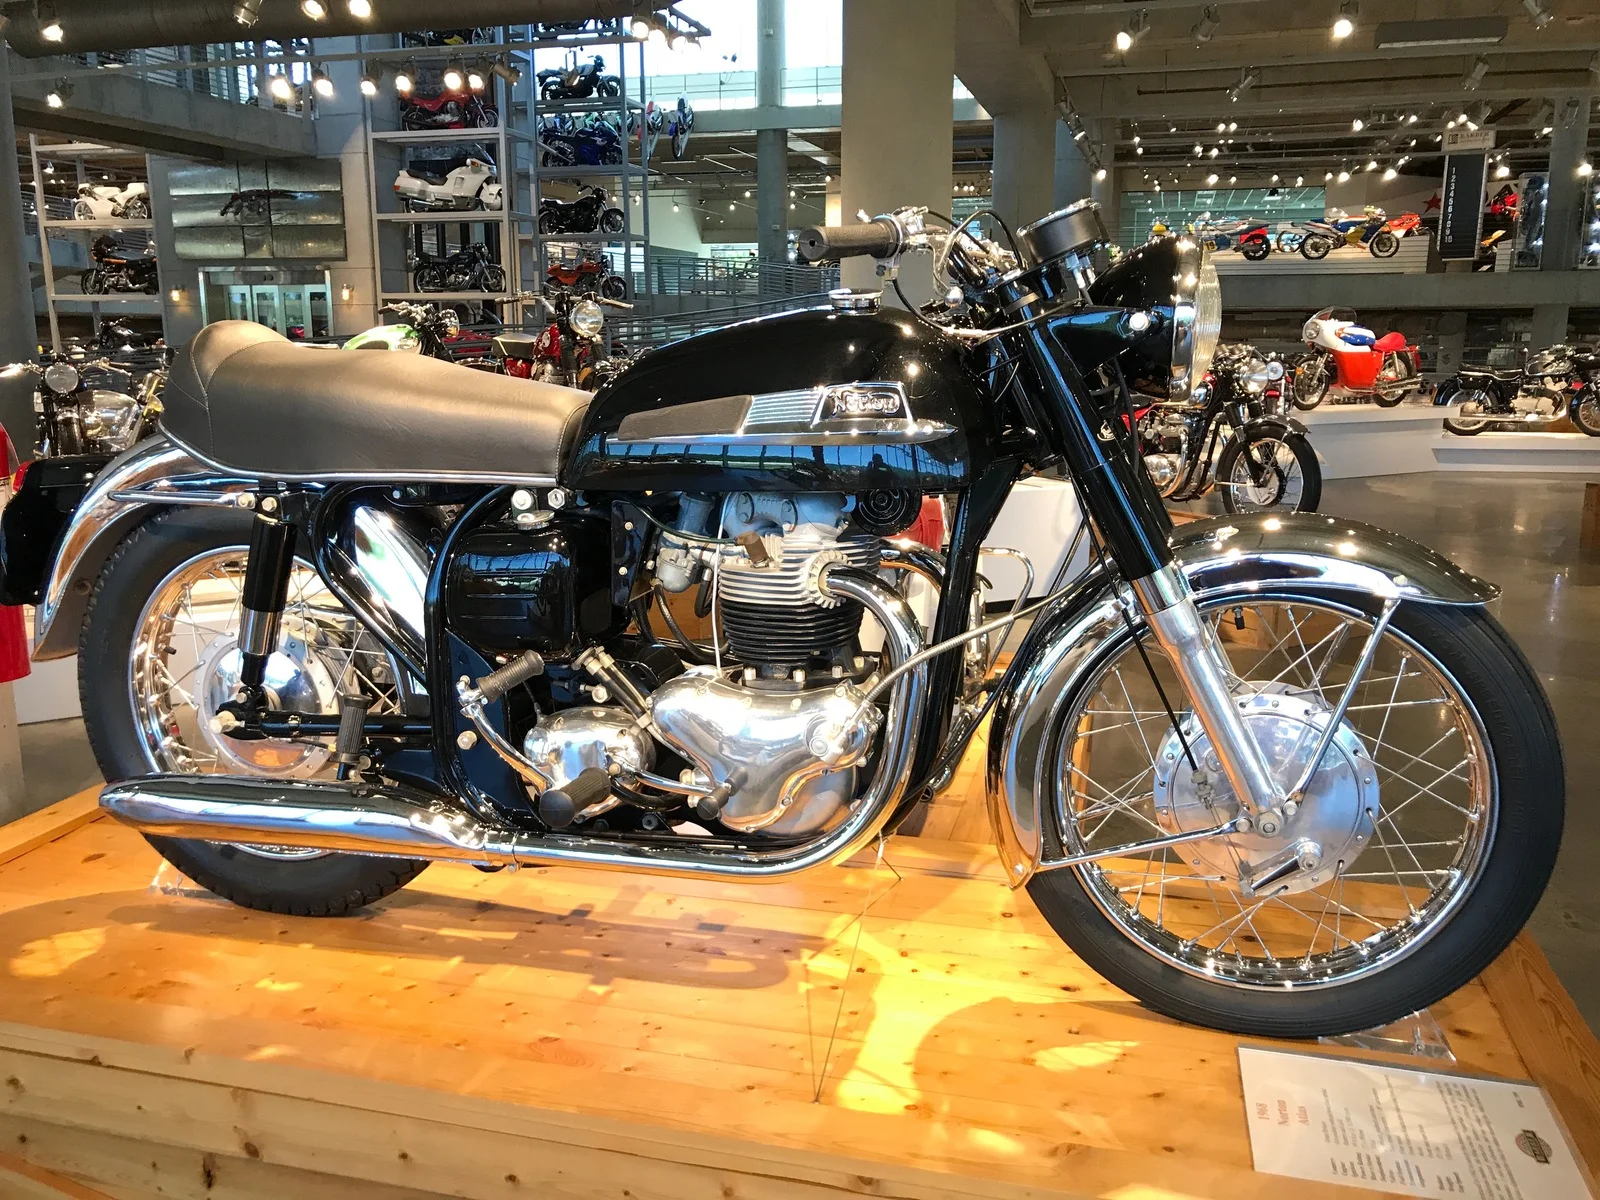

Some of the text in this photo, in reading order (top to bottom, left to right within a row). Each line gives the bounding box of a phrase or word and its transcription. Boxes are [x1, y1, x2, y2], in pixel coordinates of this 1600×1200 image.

[1255, 1102, 1270, 1121] 1968
[1277, 1099, 1290, 1127] Norton
[1296, 1105, 1310, 1127] Atlas
